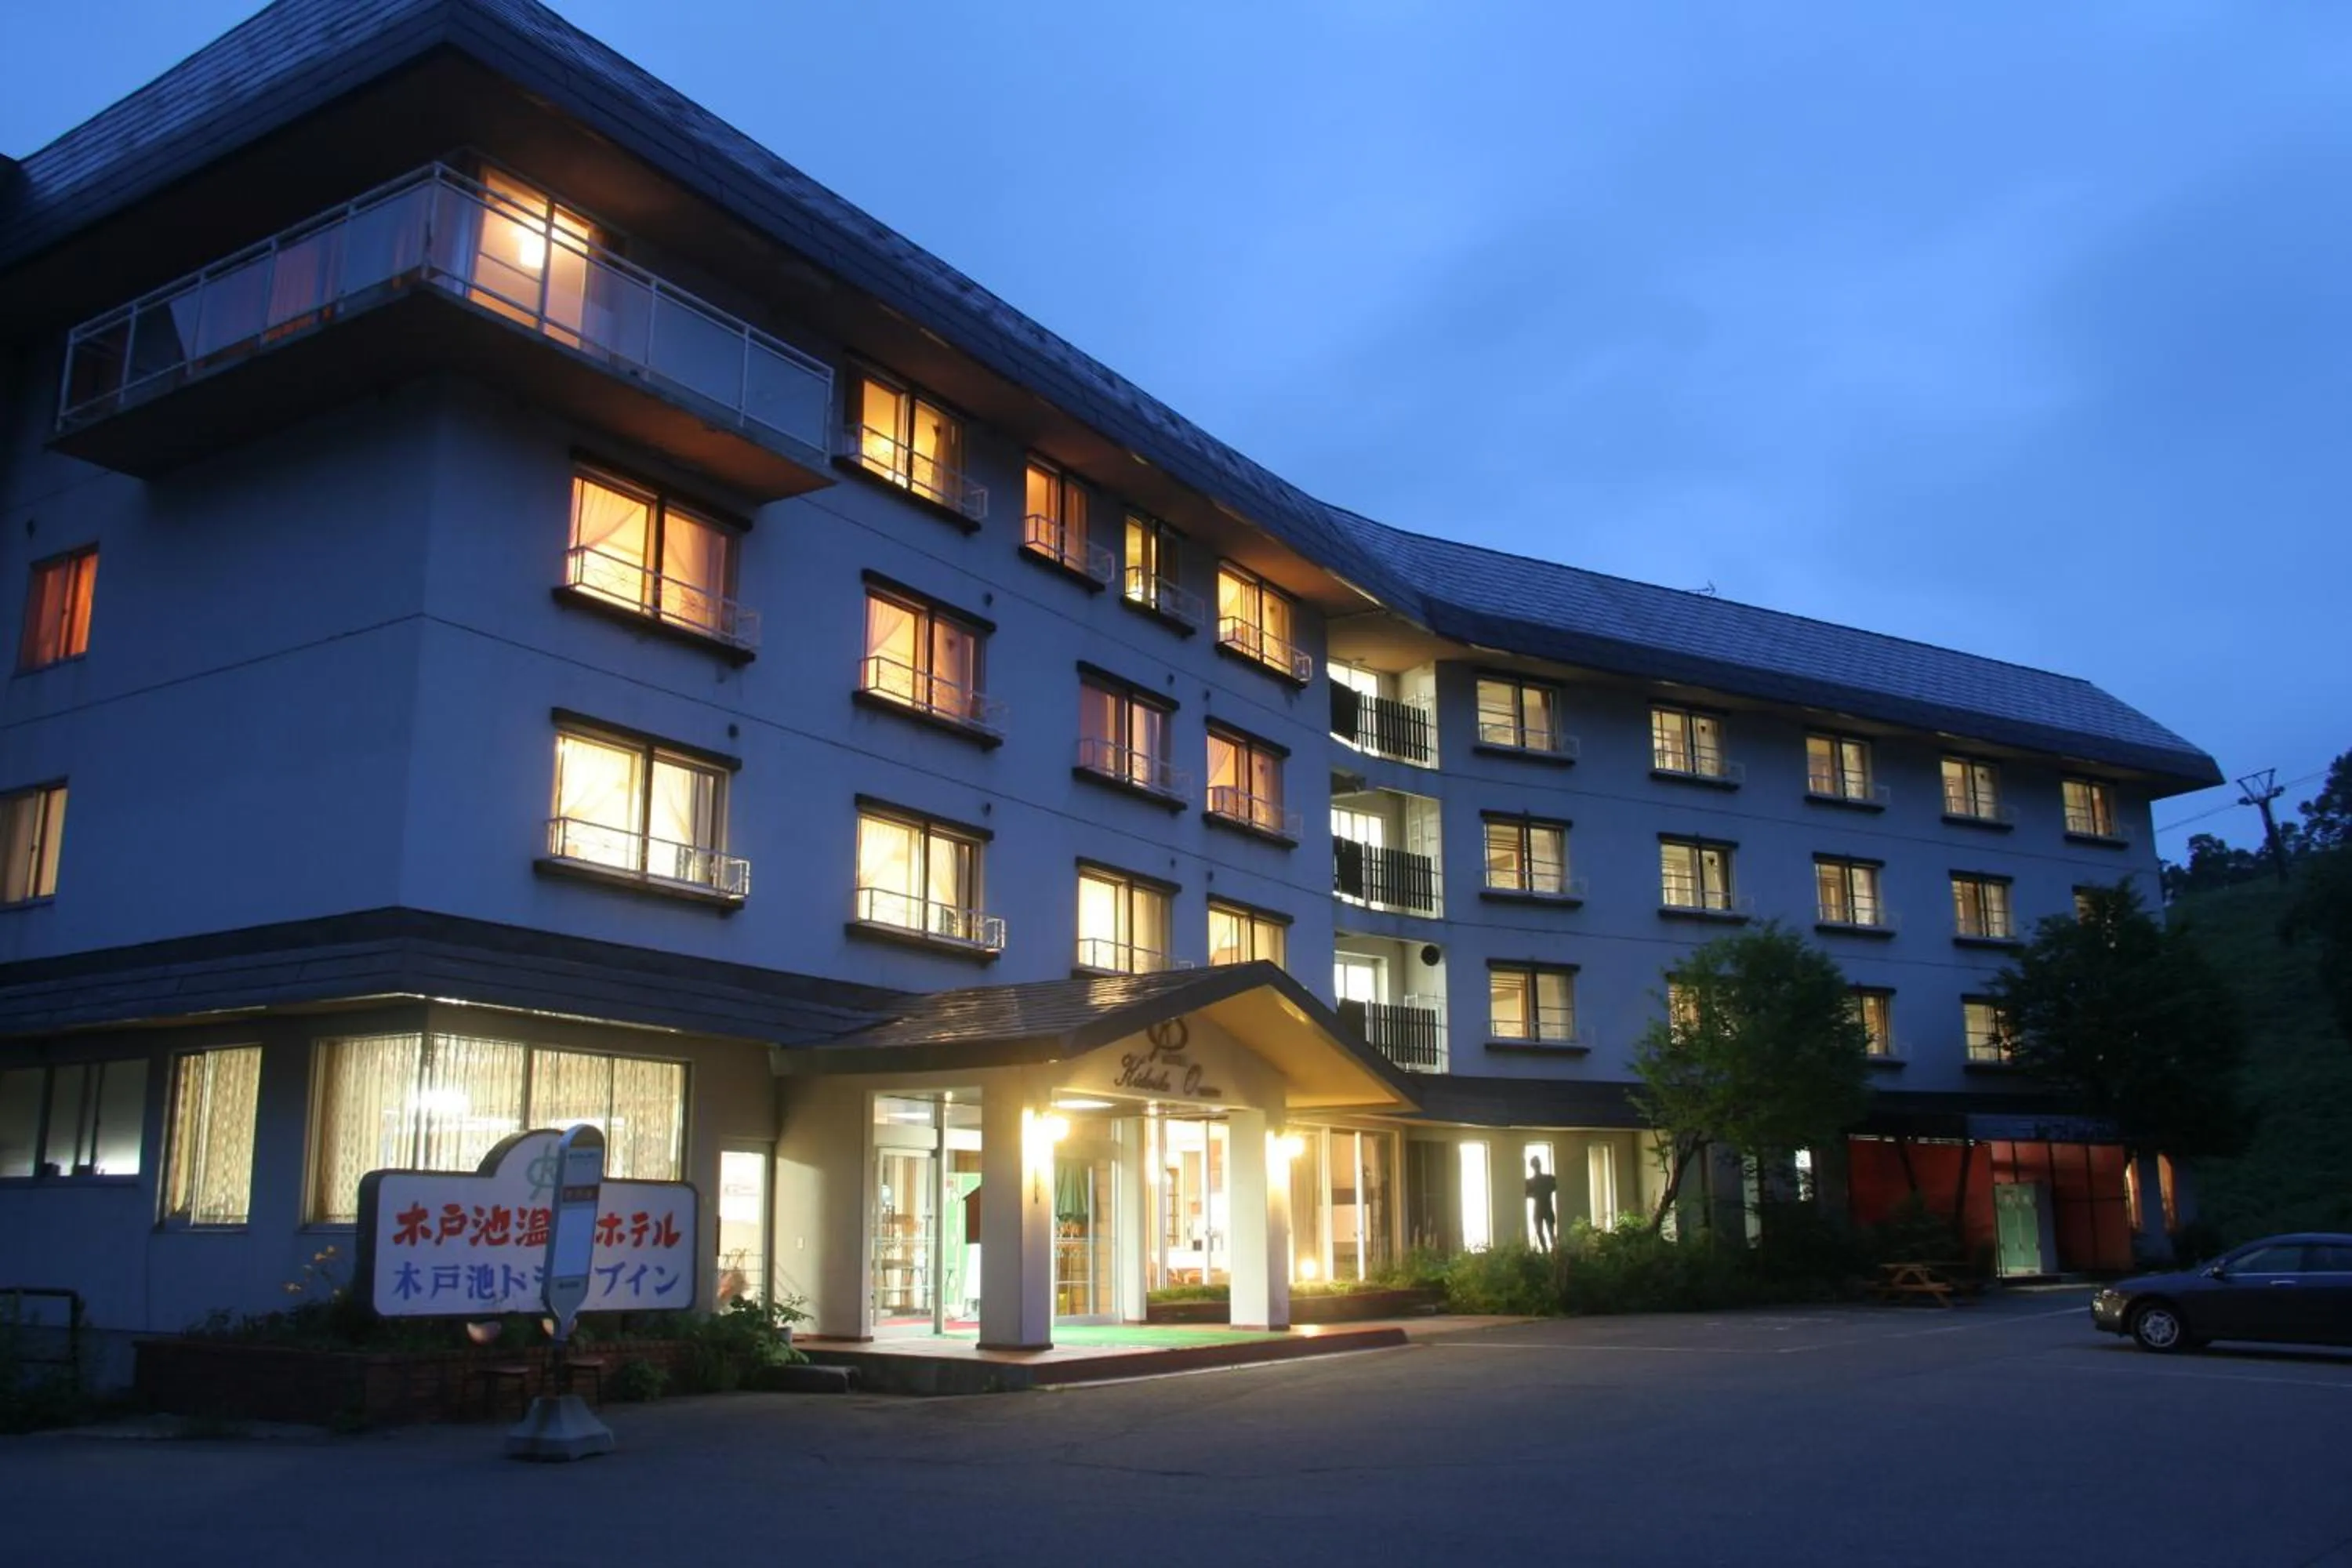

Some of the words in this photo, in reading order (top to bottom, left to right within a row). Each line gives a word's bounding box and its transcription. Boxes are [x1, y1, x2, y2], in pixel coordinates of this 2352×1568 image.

[393, 1201, 681, 1247] 木戸池温ホテル
